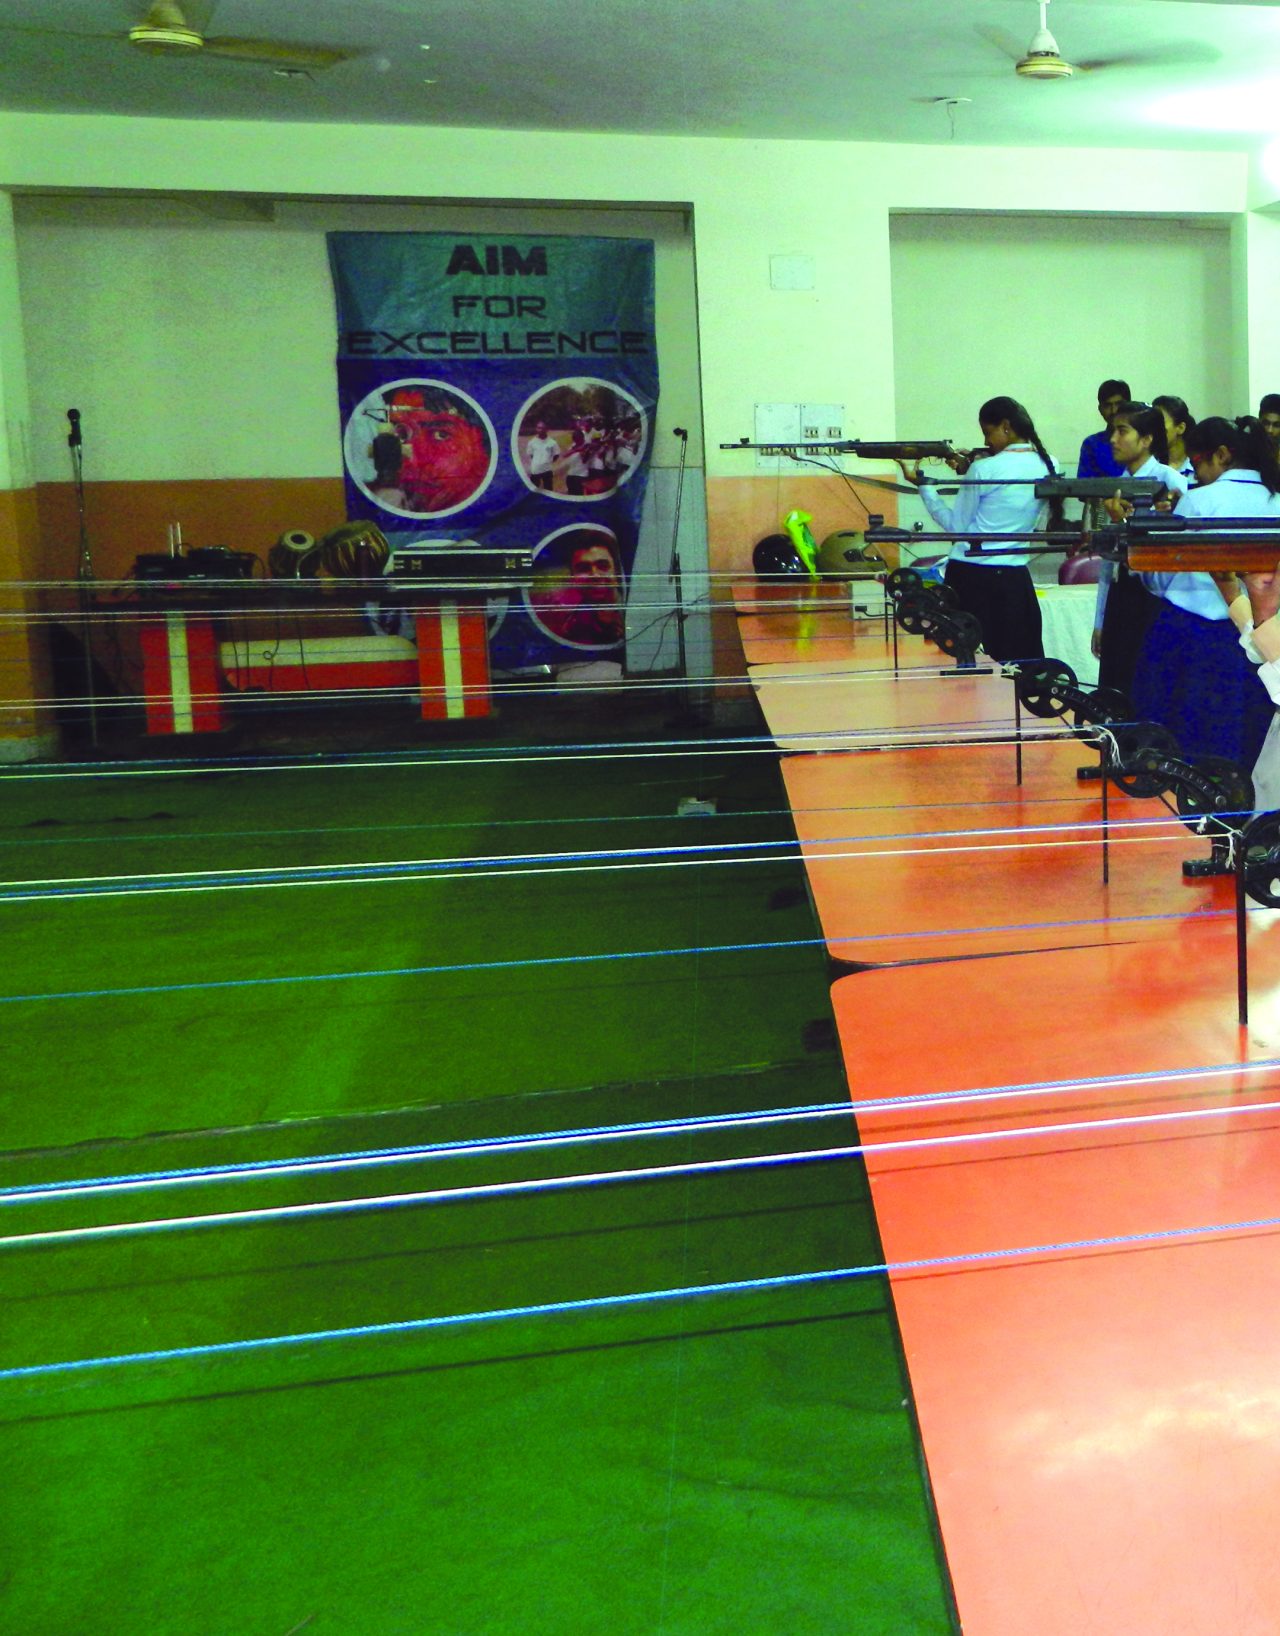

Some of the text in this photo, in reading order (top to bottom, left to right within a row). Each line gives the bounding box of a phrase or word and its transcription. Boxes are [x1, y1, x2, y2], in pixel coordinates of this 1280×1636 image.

[445, 245, 548, 275] AIM
[453, 295, 546, 318] FOR
[346, 331, 647, 355] EXCELLENCE
